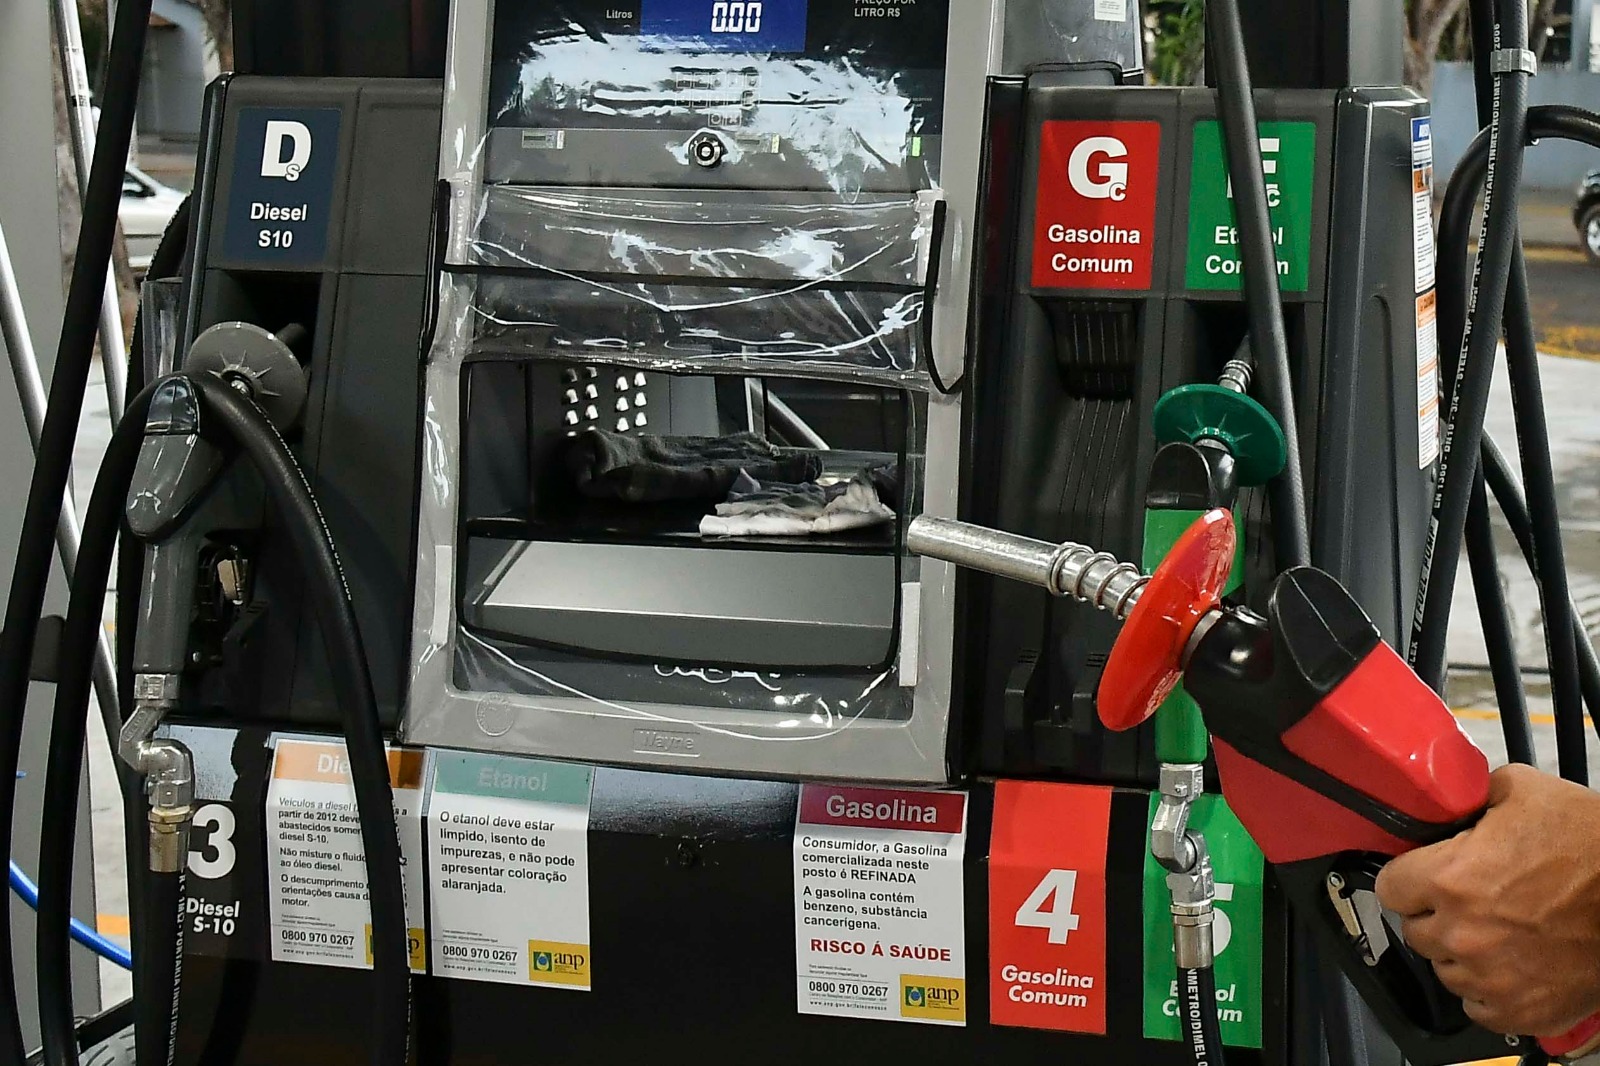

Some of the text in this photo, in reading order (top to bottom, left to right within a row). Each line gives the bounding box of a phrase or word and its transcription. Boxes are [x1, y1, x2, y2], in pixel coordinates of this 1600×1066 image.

[606, 10, 633, 19] Litros
[711, 2, 762, 33] 0.00
[854, 8, 901, 17] LITRO R$
[250, 203, 307, 221] Diesel
[258, 230, 293, 248] S10
[1048, 224, 1141, 244] Gasolina
[1051, 253, 1133, 274] Comum
[1415, 575, 1429, 617] FUEL
[1456, 344, 1469, 380] STEEL
[1483, 162, 1496, 218] PORTARIA
[640, 731, 695, 750] Wayne
[317, 754, 350, 774] Die
[479, 767, 547, 791] Etanol
[325, 801, 352, 812] diesel
[826, 794, 937, 824] Gasolina
[279, 810, 360, 823] partir de 2012 deve
[440, 811, 555, 831] O etanol deve estar
[279, 820, 331, 832] abastecidos
[187, 803, 236, 879] 3
[279, 831, 329, 844] diesel S-10.
[491, 832, 527, 846] isento
[531, 836, 546, 847] de
[802, 836, 948, 857] Consumidor, a Gasolina
[280, 847, 298, 857] Não
[300, 850, 332, 860] misture
[440, 844, 575, 867] impurezas, e não pode
[802, 853, 930, 870] comercializada neste
[280, 859, 342, 872] ao óleo diesel.
[441, 863, 567, 883] apresentar coloração
[281, 874, 364, 889] O descumprimento
[802, 867, 916, 884] posto é REFINADA
[281, 887, 332, 900] orientações
[334, 891, 361, 900] causa
[441, 878, 506, 894] alaranjada.
[803, 886, 915, 904] A gasolina contém
[186, 897, 240, 918] Diesel
[281, 898, 310, 907] motor.
[803, 900, 928, 919] benzeno, substância
[1015, 868, 1080, 945] 4
[193, 916, 235, 936] S-10
[804, 916, 880, 930] cancerígena.
[281, 930, 354, 946] 0800 970 0267
[173, 930, 184, 986] PORTARIA
[443, 945, 518, 962] 0800 970 0267
[810, 939, 951, 961] RISCO Á SAÚDE
[553, 952, 585, 970] anp
[1001, 965, 1094, 989] Gasolina
[809, 981, 888, 997] 0800 970 0267
[927, 986, 959, 1005] anp
[1008, 985, 1087, 1007] Comum
[1187, 968, 1206, 1059] NMETRO/DIMEL
